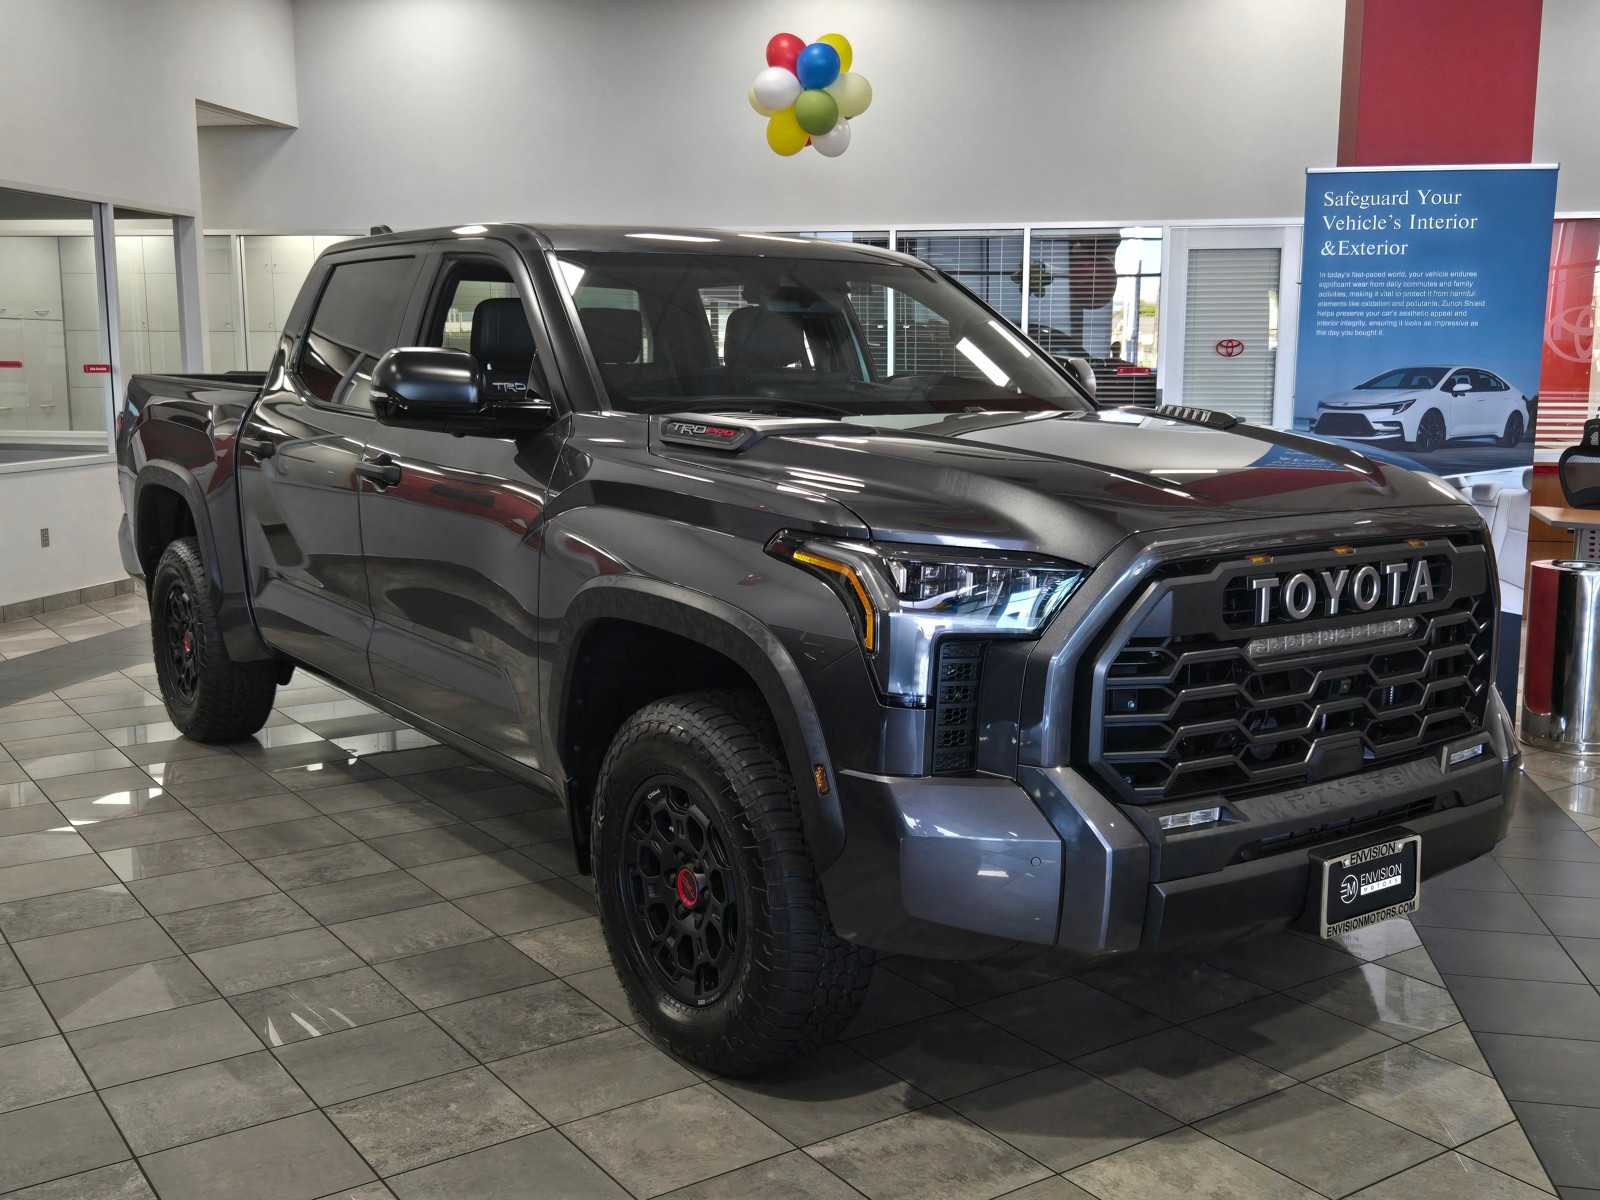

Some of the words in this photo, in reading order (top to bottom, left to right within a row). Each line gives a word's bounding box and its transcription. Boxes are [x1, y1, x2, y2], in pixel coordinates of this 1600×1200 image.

[1323, 190, 1409, 209] Safeguard
[1418, 189, 1462, 205] Your
[1322, 214, 1401, 230] Vehicle's
[1409, 214, 1477, 230] Interior
[1320, 240, 1408, 256] &Exterior
[1253, 560, 1434, 623] TOYOTA
[1350, 842, 1395, 865] ENVISION
[1360, 863, 1401, 885] ENVISION
[1327, 901, 1415, 937] ENVISIONMOTORS.COM
